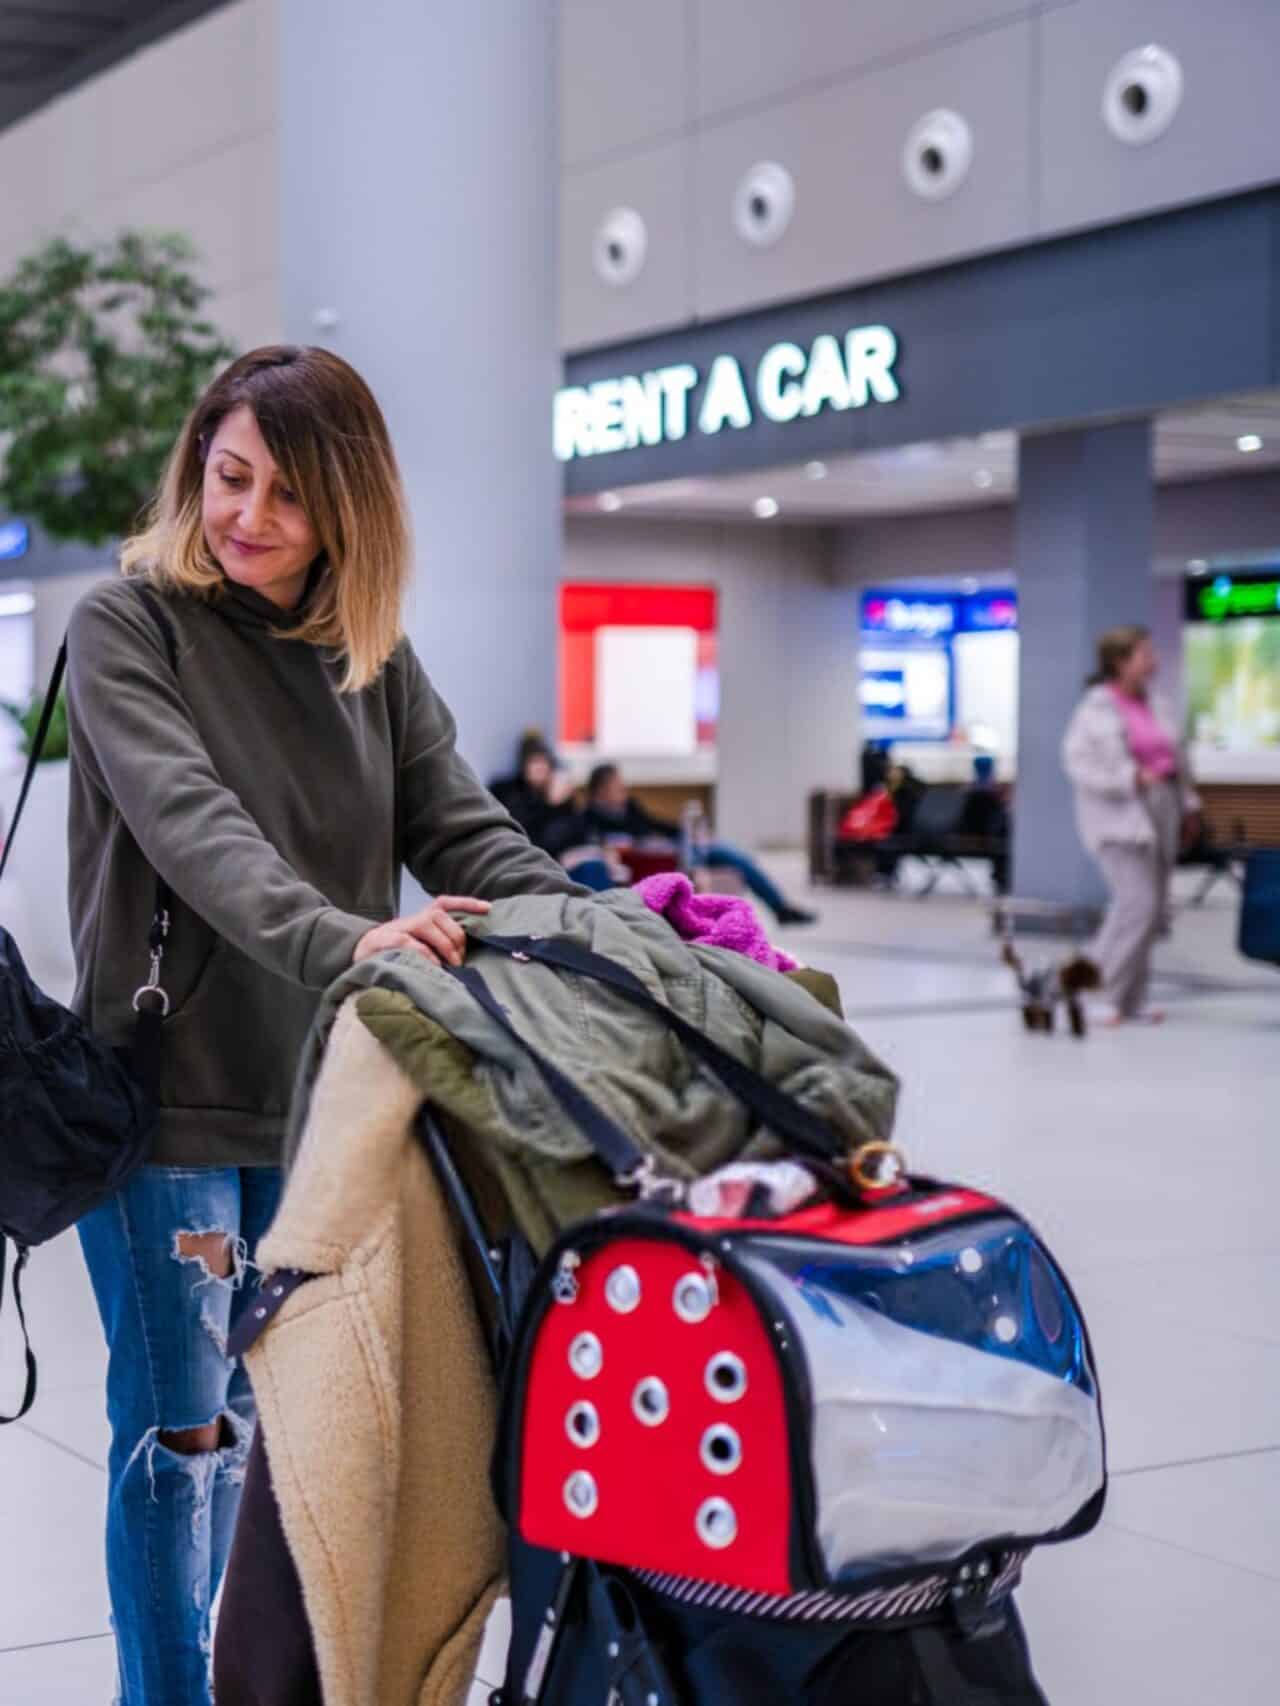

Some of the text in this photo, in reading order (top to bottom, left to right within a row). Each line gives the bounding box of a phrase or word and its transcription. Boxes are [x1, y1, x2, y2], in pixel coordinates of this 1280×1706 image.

[552, 325, 898, 461] RENT A CAR
